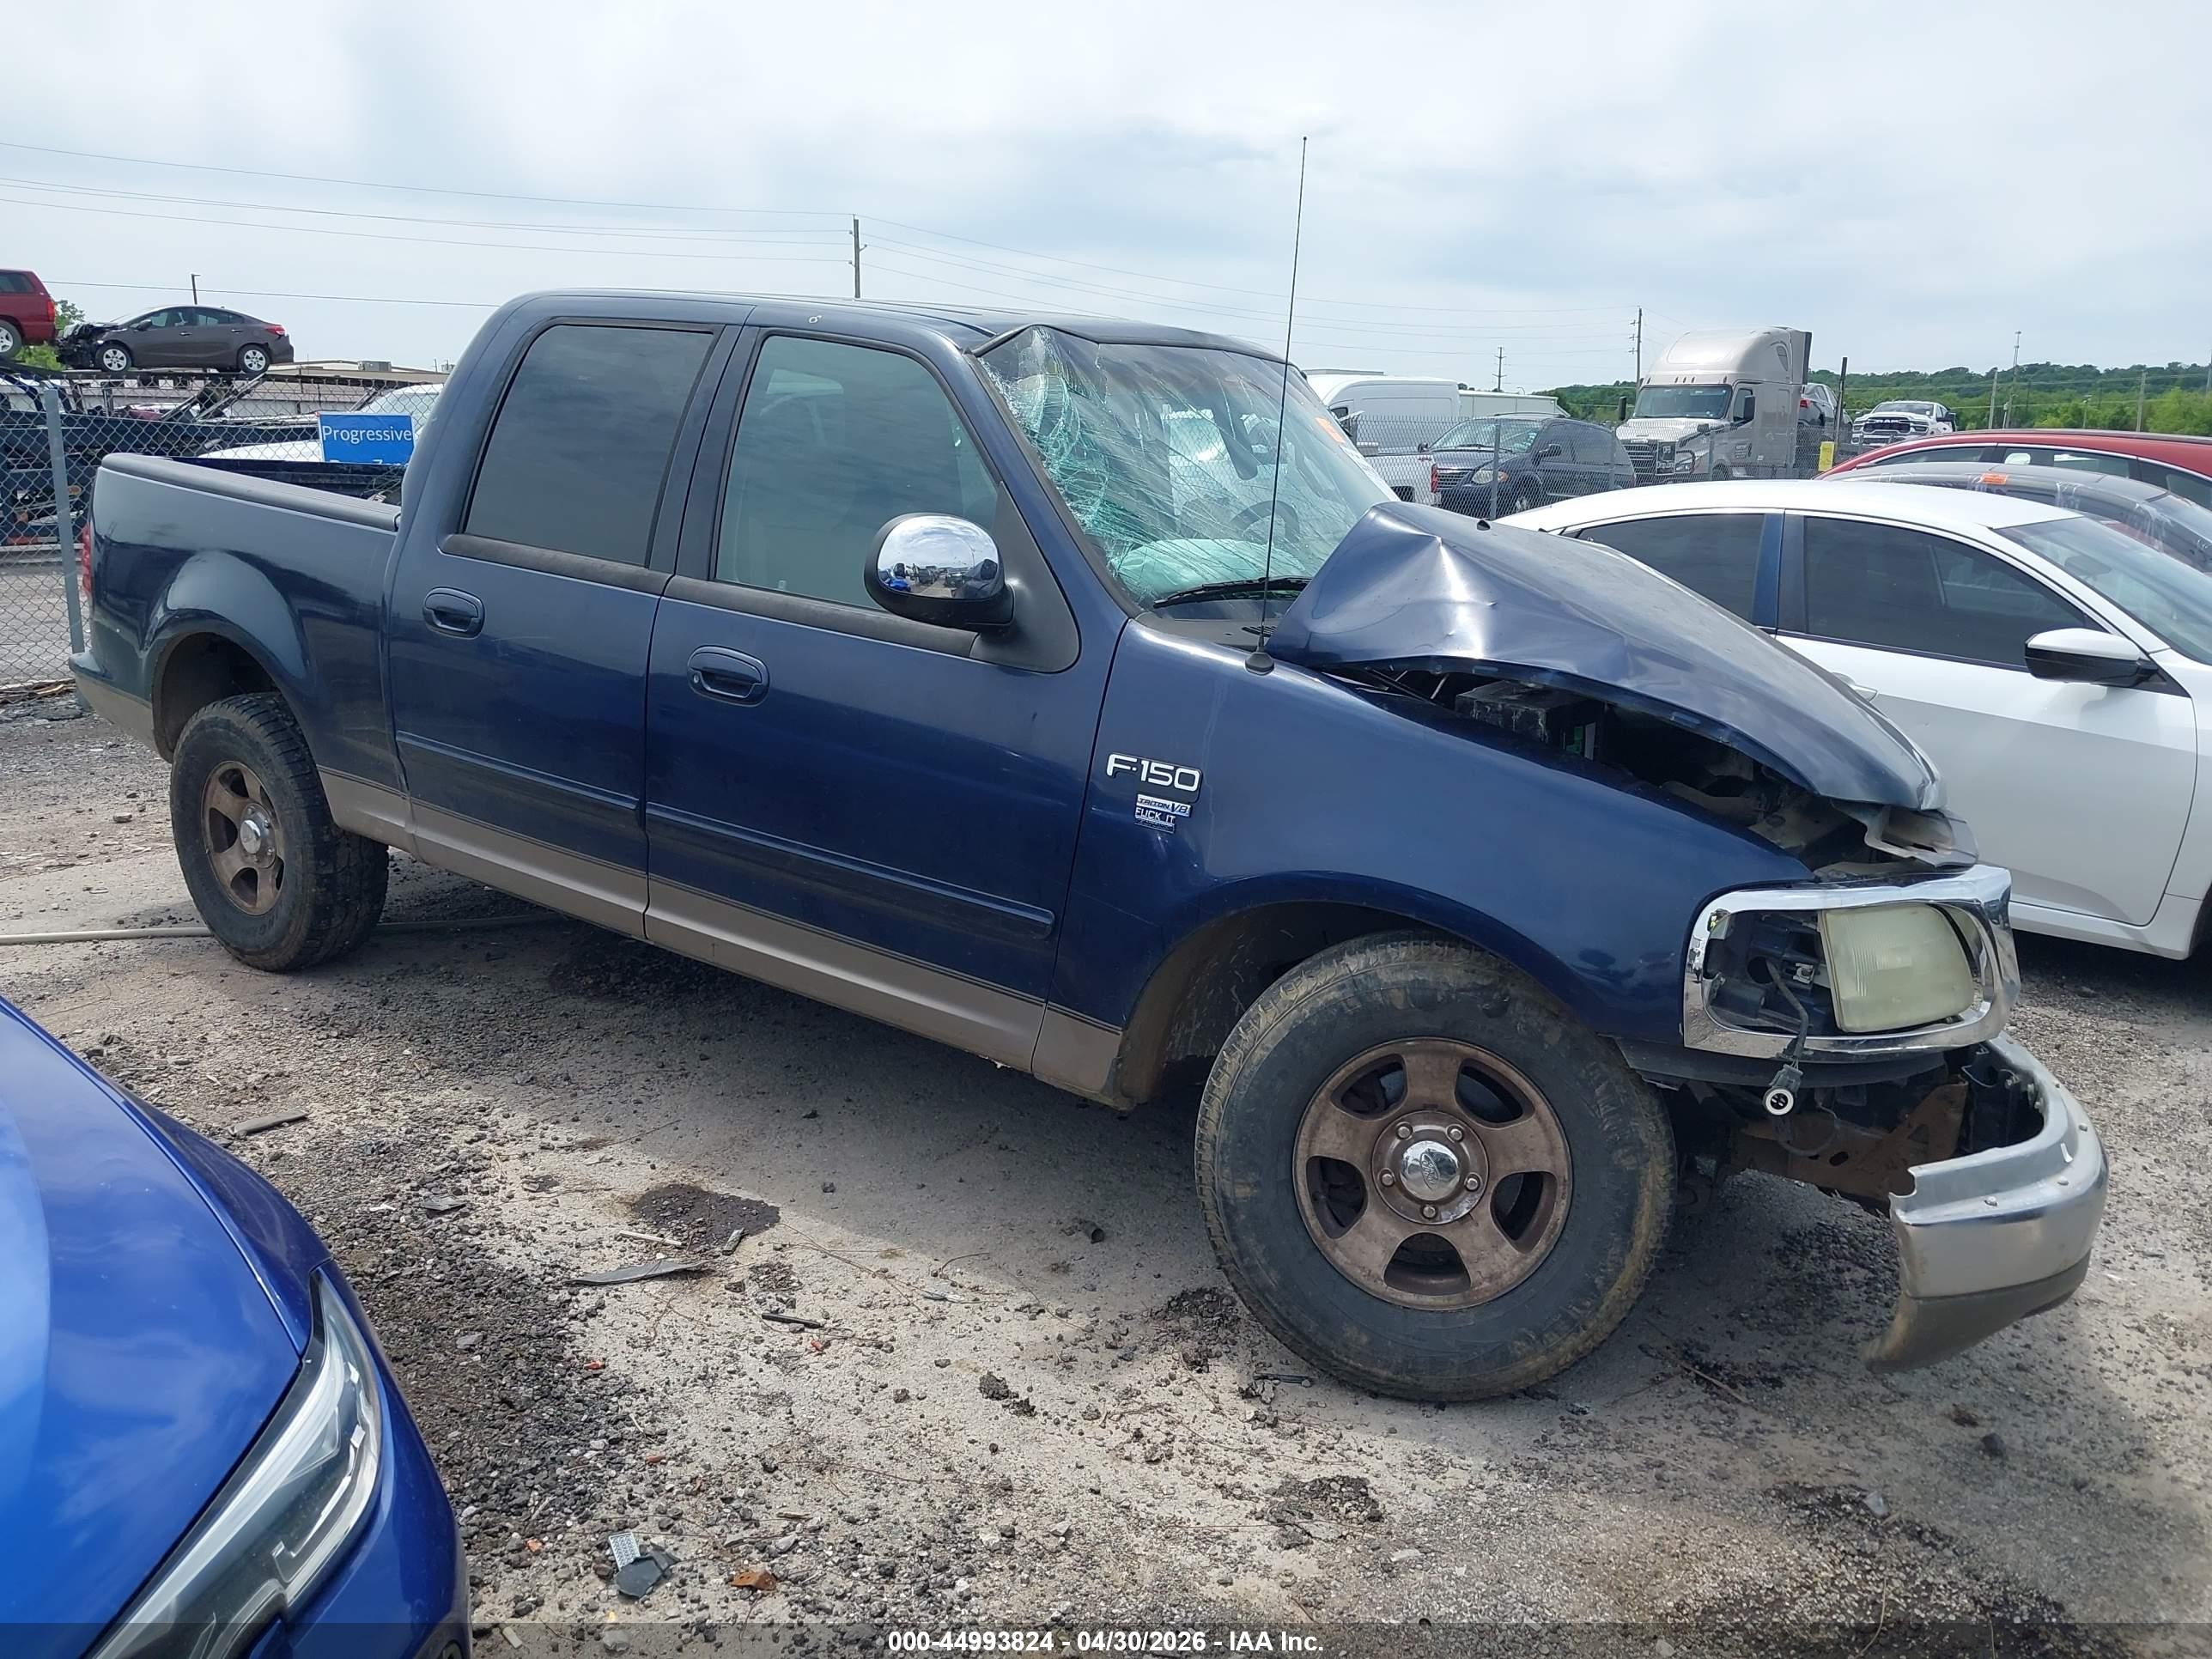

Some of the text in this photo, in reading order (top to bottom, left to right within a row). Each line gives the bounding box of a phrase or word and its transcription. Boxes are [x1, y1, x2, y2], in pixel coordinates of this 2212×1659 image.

[322, 426, 412, 444] Progressive
[1106, 754, 1200, 792] F-150
[1138, 798, 1188, 814] TRITON V8
[1135, 807, 1176, 824] FUCK IT
